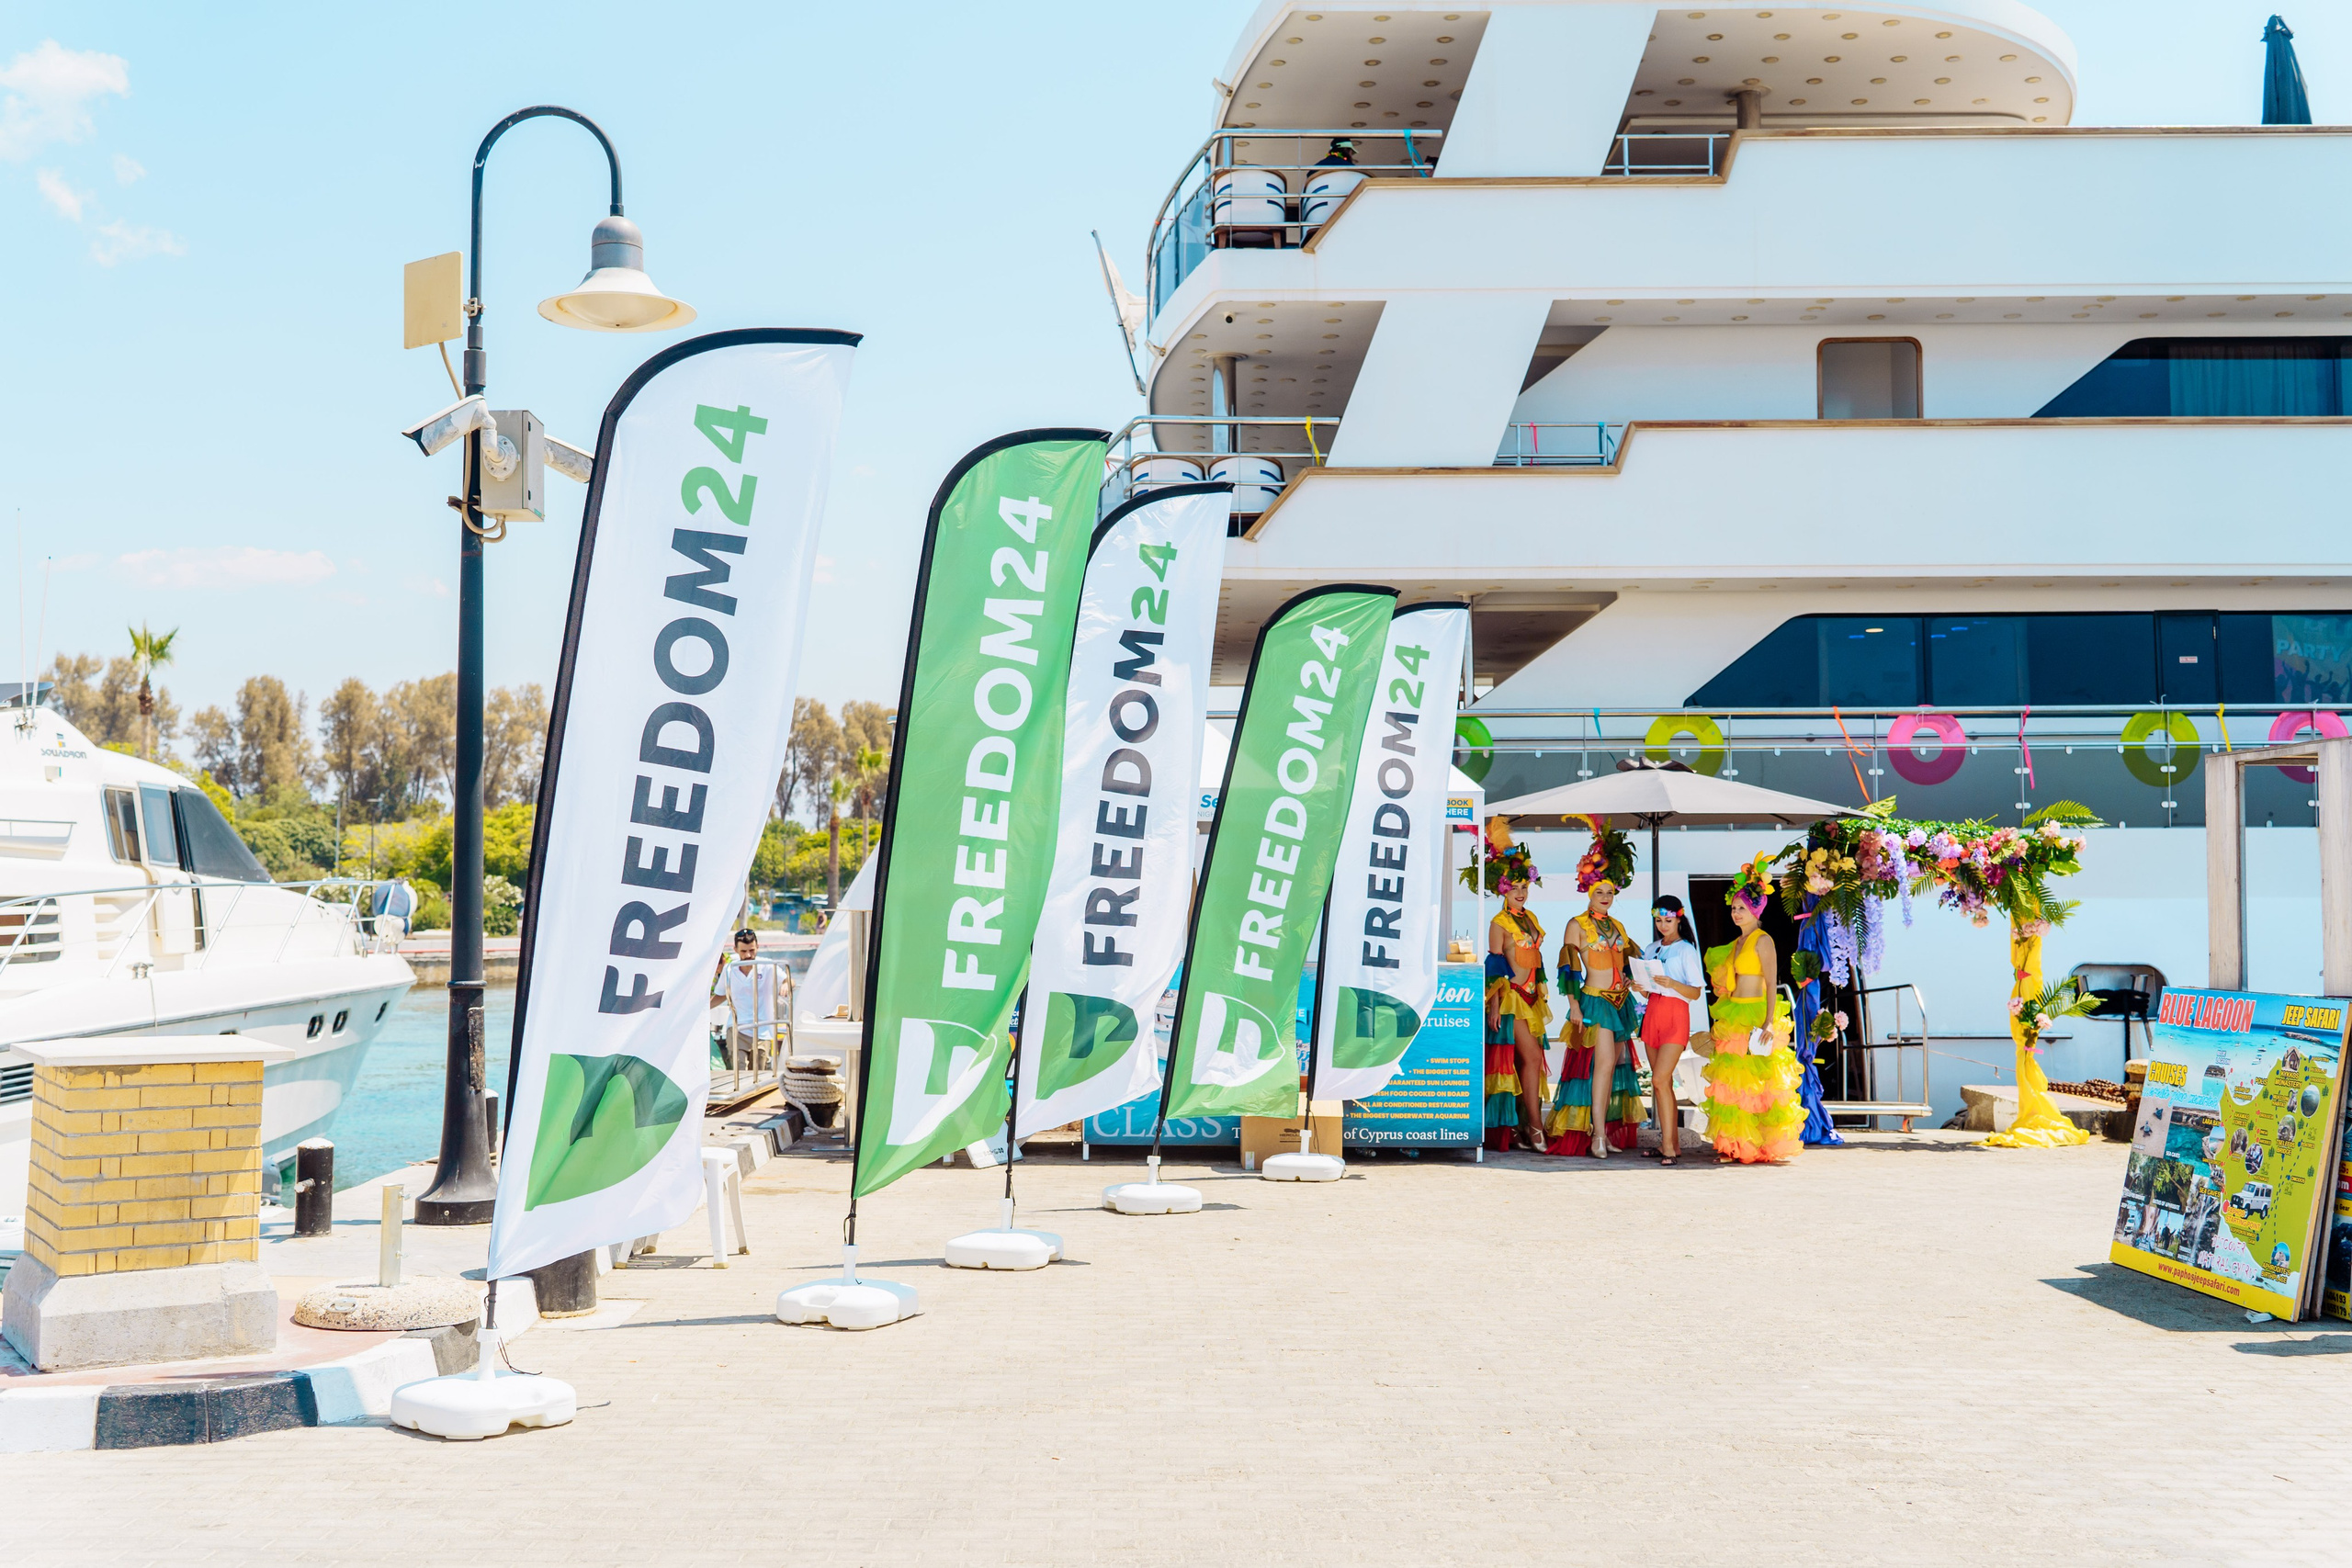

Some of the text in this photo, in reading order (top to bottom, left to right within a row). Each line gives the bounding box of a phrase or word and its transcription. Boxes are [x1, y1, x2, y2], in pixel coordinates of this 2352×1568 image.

[2276, 639, 2346, 662] PARTY
[598, 403, 769, 1016] FREEDOM24
[942, 495, 1054, 991] FREEDOM24
[1082, 540, 1179, 967] FREEDOM24
[1233, 623, 1351, 983] FREEDOM24
[1361, 643, 1430, 969] FREEDOM24
[1436, 982, 1475, 1003] ion
[2159, 993, 2256, 1032] BLUE LAGOON
[2281, 1004, 2341, 1030] JEEP SAFARI
[2148, 1061, 2188, 1088] CRUISES
[1343, 1128, 1469, 1144] of Cyprus coast lines
[2158, 1262, 2240, 1296] www.paphosjeepsafari.com
